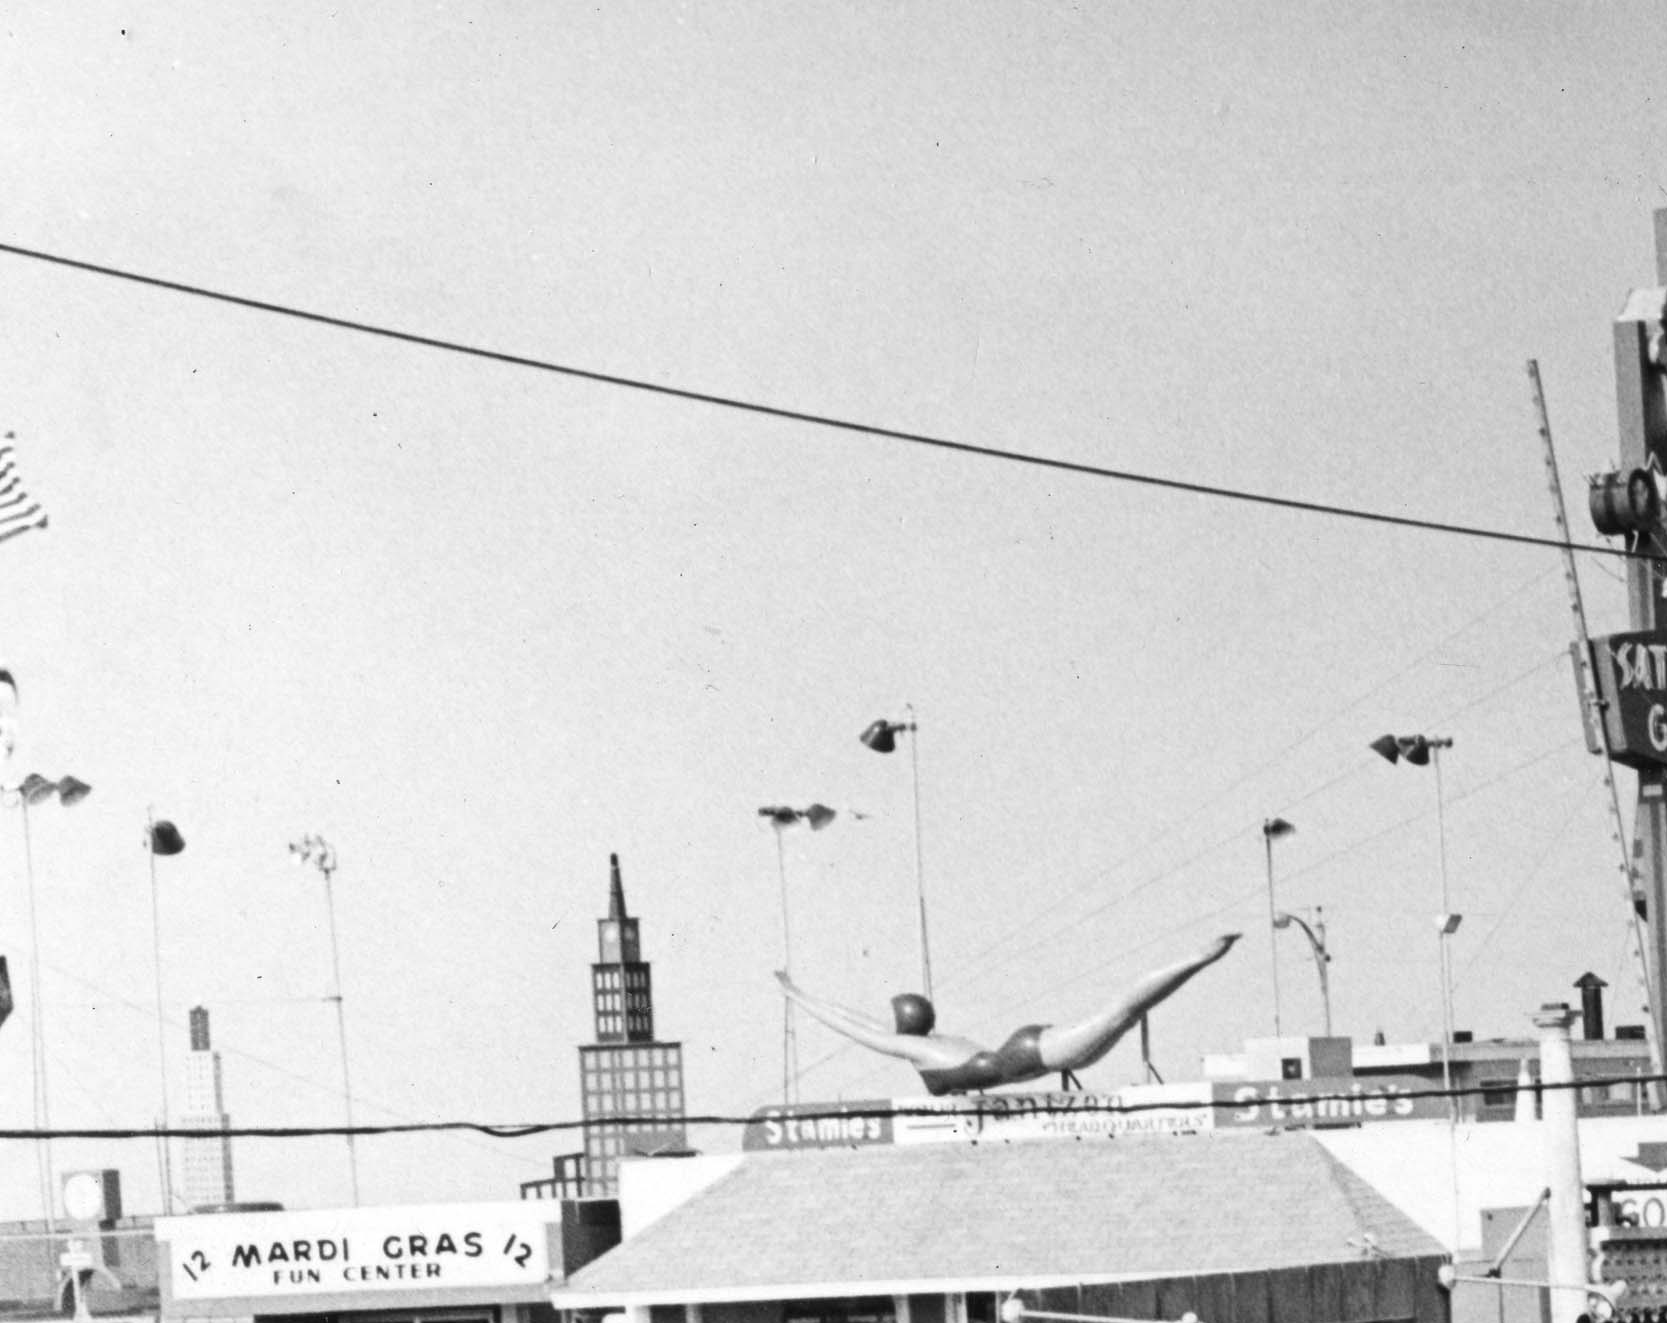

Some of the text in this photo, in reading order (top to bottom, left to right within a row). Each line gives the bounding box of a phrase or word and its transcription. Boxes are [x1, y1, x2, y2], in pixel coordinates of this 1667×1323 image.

[232, 1237, 350, 1269] MARDI
[383, 1231, 484, 1260] GRAS
[274, 1262, 443, 1286] FUN CENTER
